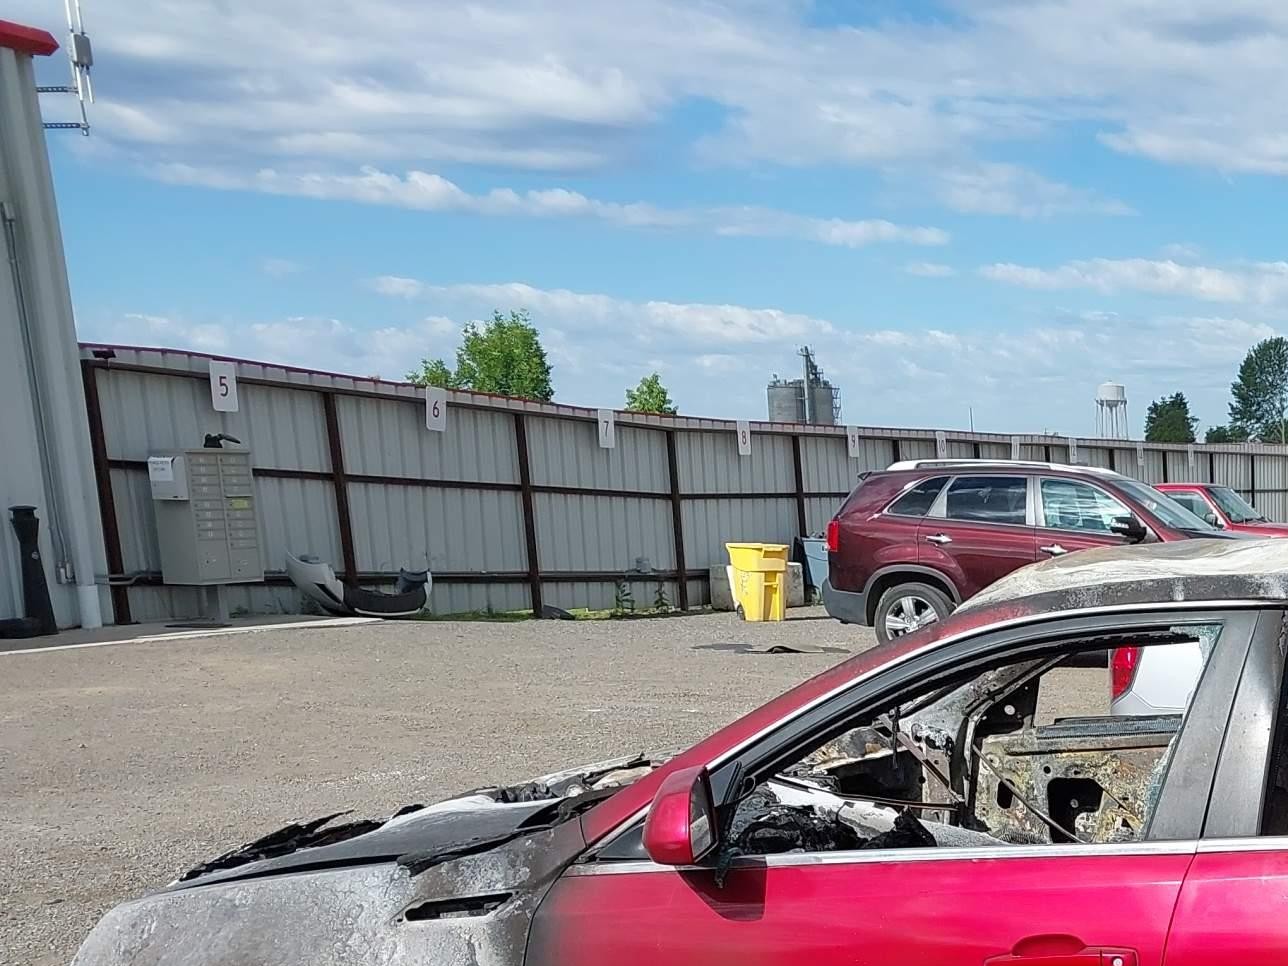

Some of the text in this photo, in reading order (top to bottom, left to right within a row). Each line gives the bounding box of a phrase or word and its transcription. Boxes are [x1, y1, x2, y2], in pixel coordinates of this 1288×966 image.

[219, 375, 229, 397] 5
[432, 400, 440, 418] 6
[603, 420, 610, 438] 7
[741, 430, 747, 446] 8
[850, 434, 856, 448] 9
